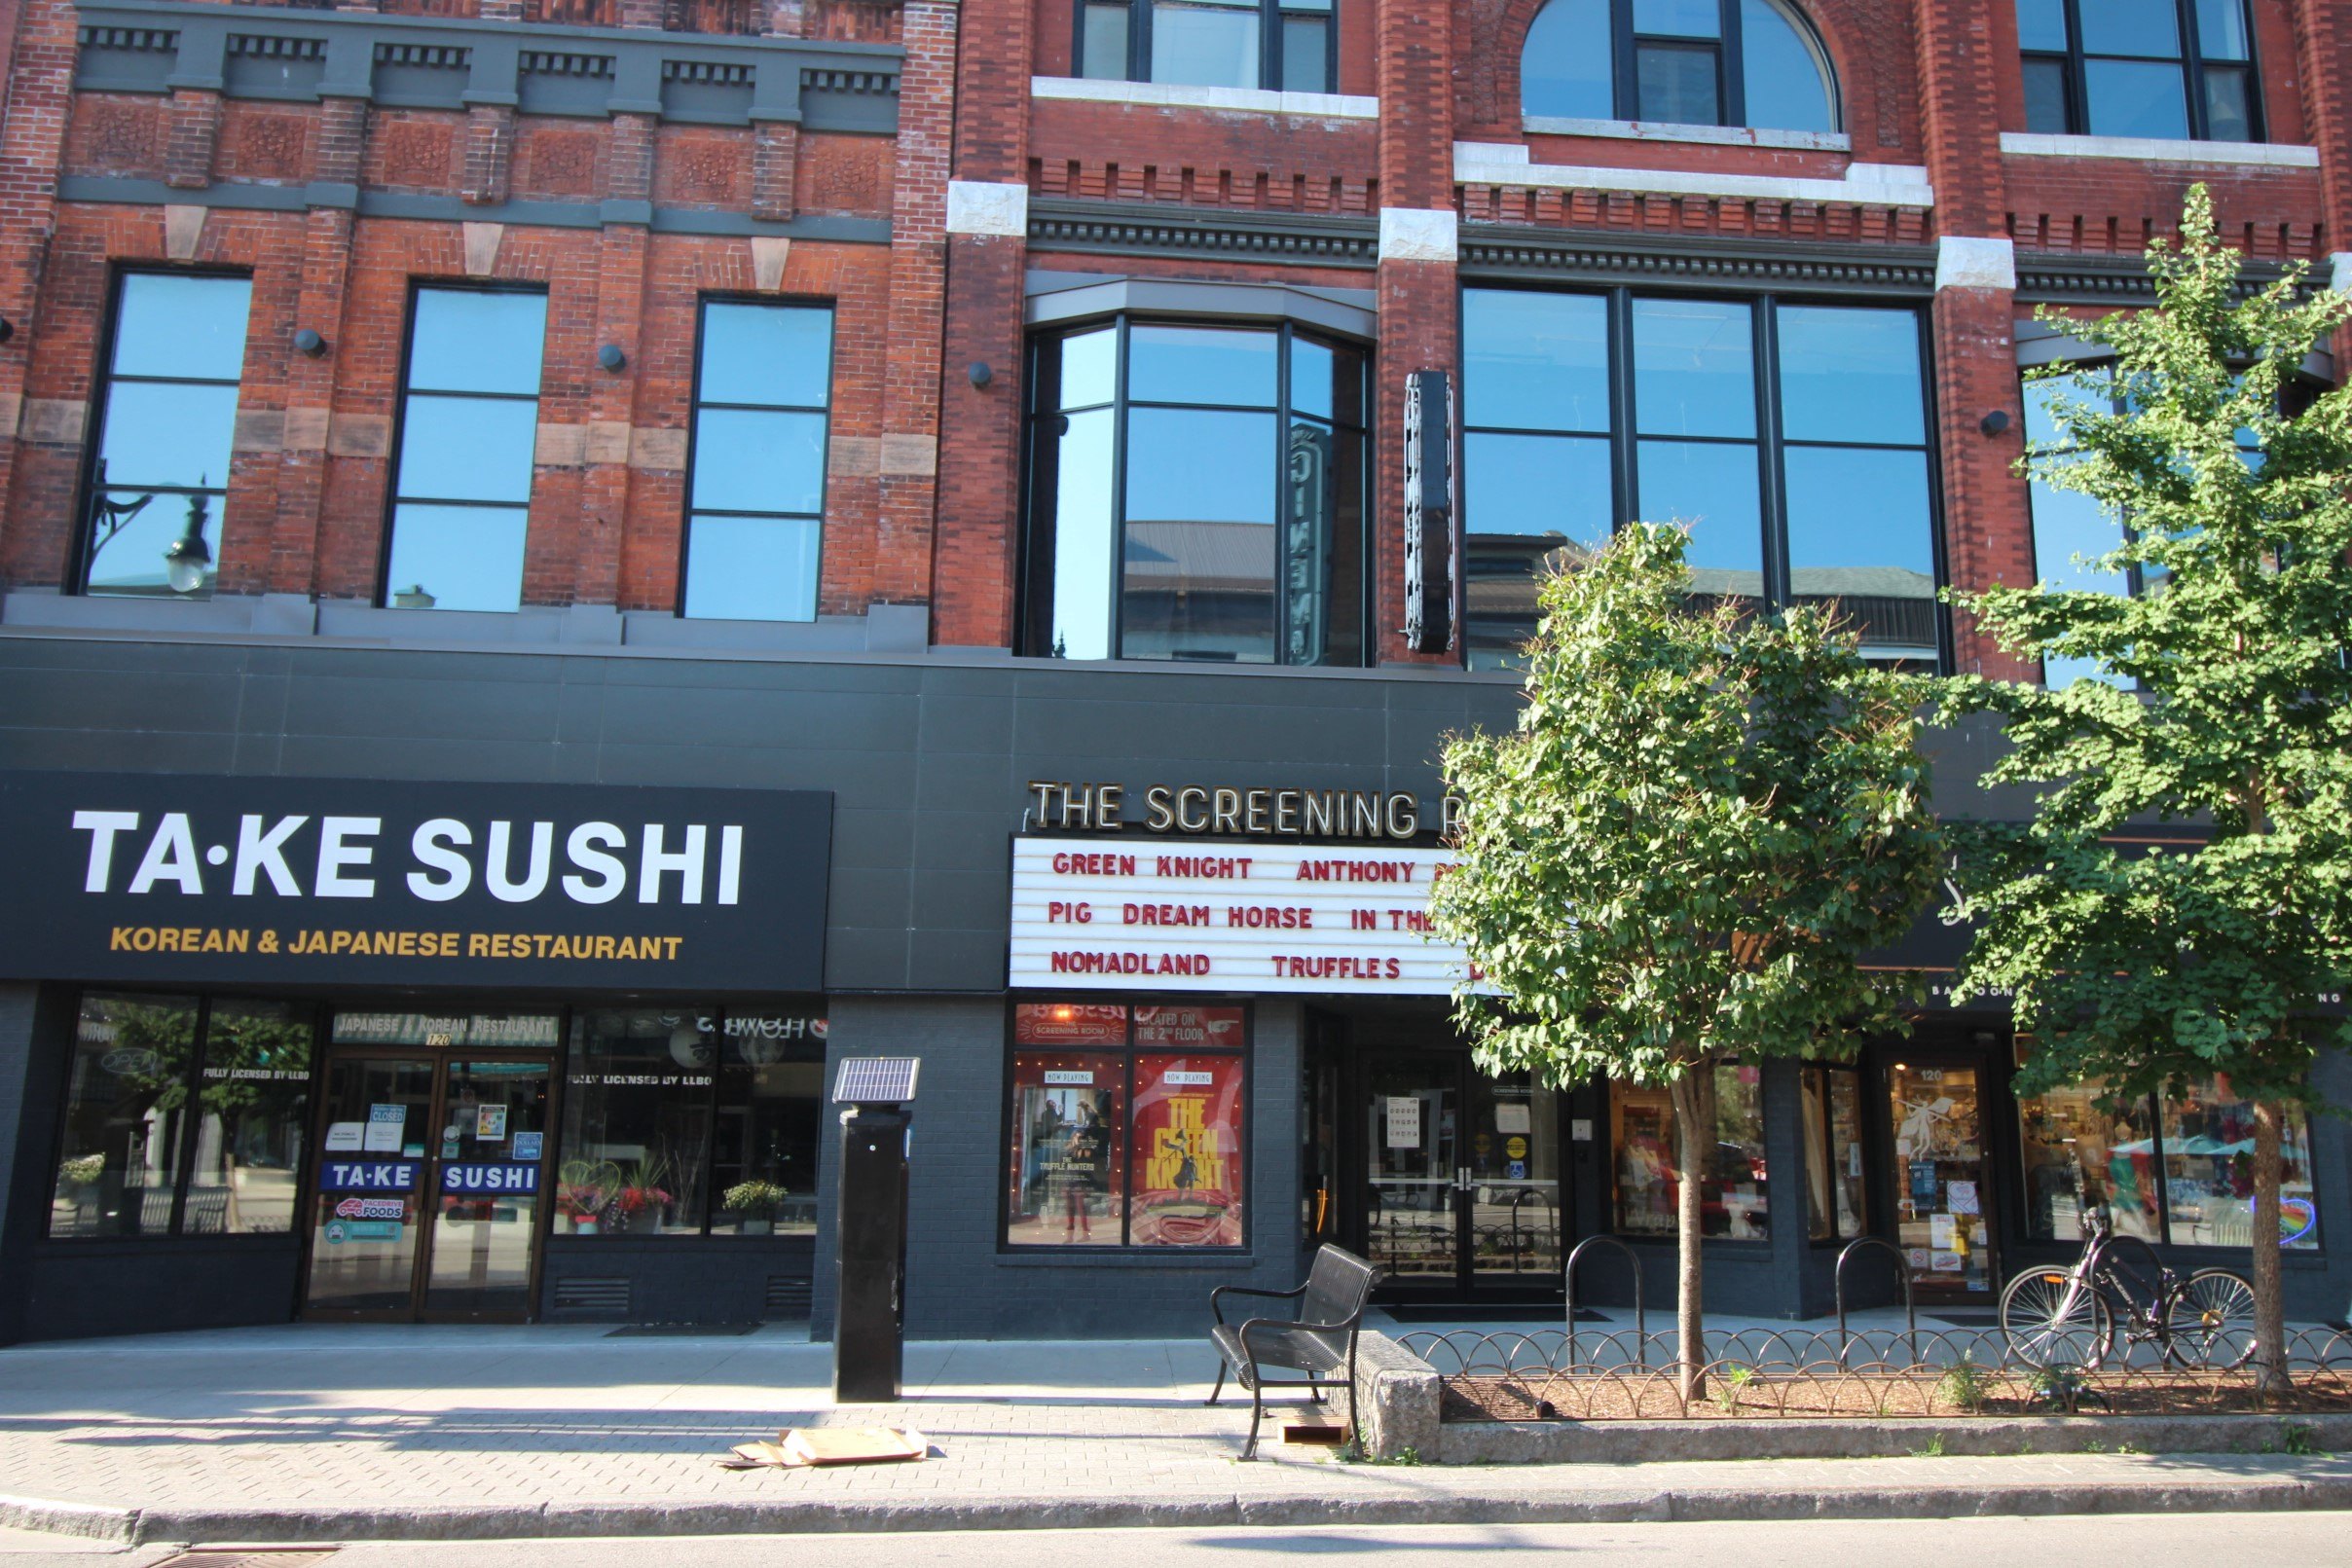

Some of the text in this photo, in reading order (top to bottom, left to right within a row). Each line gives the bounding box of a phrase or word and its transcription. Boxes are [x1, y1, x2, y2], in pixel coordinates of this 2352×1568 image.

[1028, 780, 1123, 830] THE
[1143, 783, 1418, 839] SCREENING
[406, 818, 743, 904] SUSHI
[1052, 853, 1136, 877] GREEN
[1157, 856, 1253, 880] KNIGHT
[1296, 859, 1415, 883] ANTHONY
[1047, 901, 1092, 925] PIG
[1122, 902, 1210, 927] DREAM
[1228, 905, 1313, 930] HORSE
[1351, 908, 1377, 930] IN
[110, 927, 682, 962] KOREAN & JAPANESE RESTAURANT
[1051, 950, 1400, 979] NOMADLAND TRUFFLES
[339, 1018, 552, 1035] JAPANESE & KOREAN RESTAURANT
[1182, 1013, 1195, 1025] ON
[428, 1035, 451, 1045] 120
[1138, 1028, 1155, 1039] THE
[1175, 1028, 1203, 1040] FLOOR
[101, 1051, 157, 1070] OPEN
[203, 1068, 227, 1077] FULLY
[231, 1069, 271, 1079] LICENSED
[275, 1070, 284, 1079] BY
[604, 1075, 658, 1084] LICENSED
[662, 1076, 678, 1084] BY
[1921, 1070, 1943, 1081] 120
[373, 1112, 403, 1121] CLOSED
[1168, 1098, 1205, 1129] THE
[446, 1167, 534, 1188] SUSHI
[363, 1207, 401, 1217] FOODS
